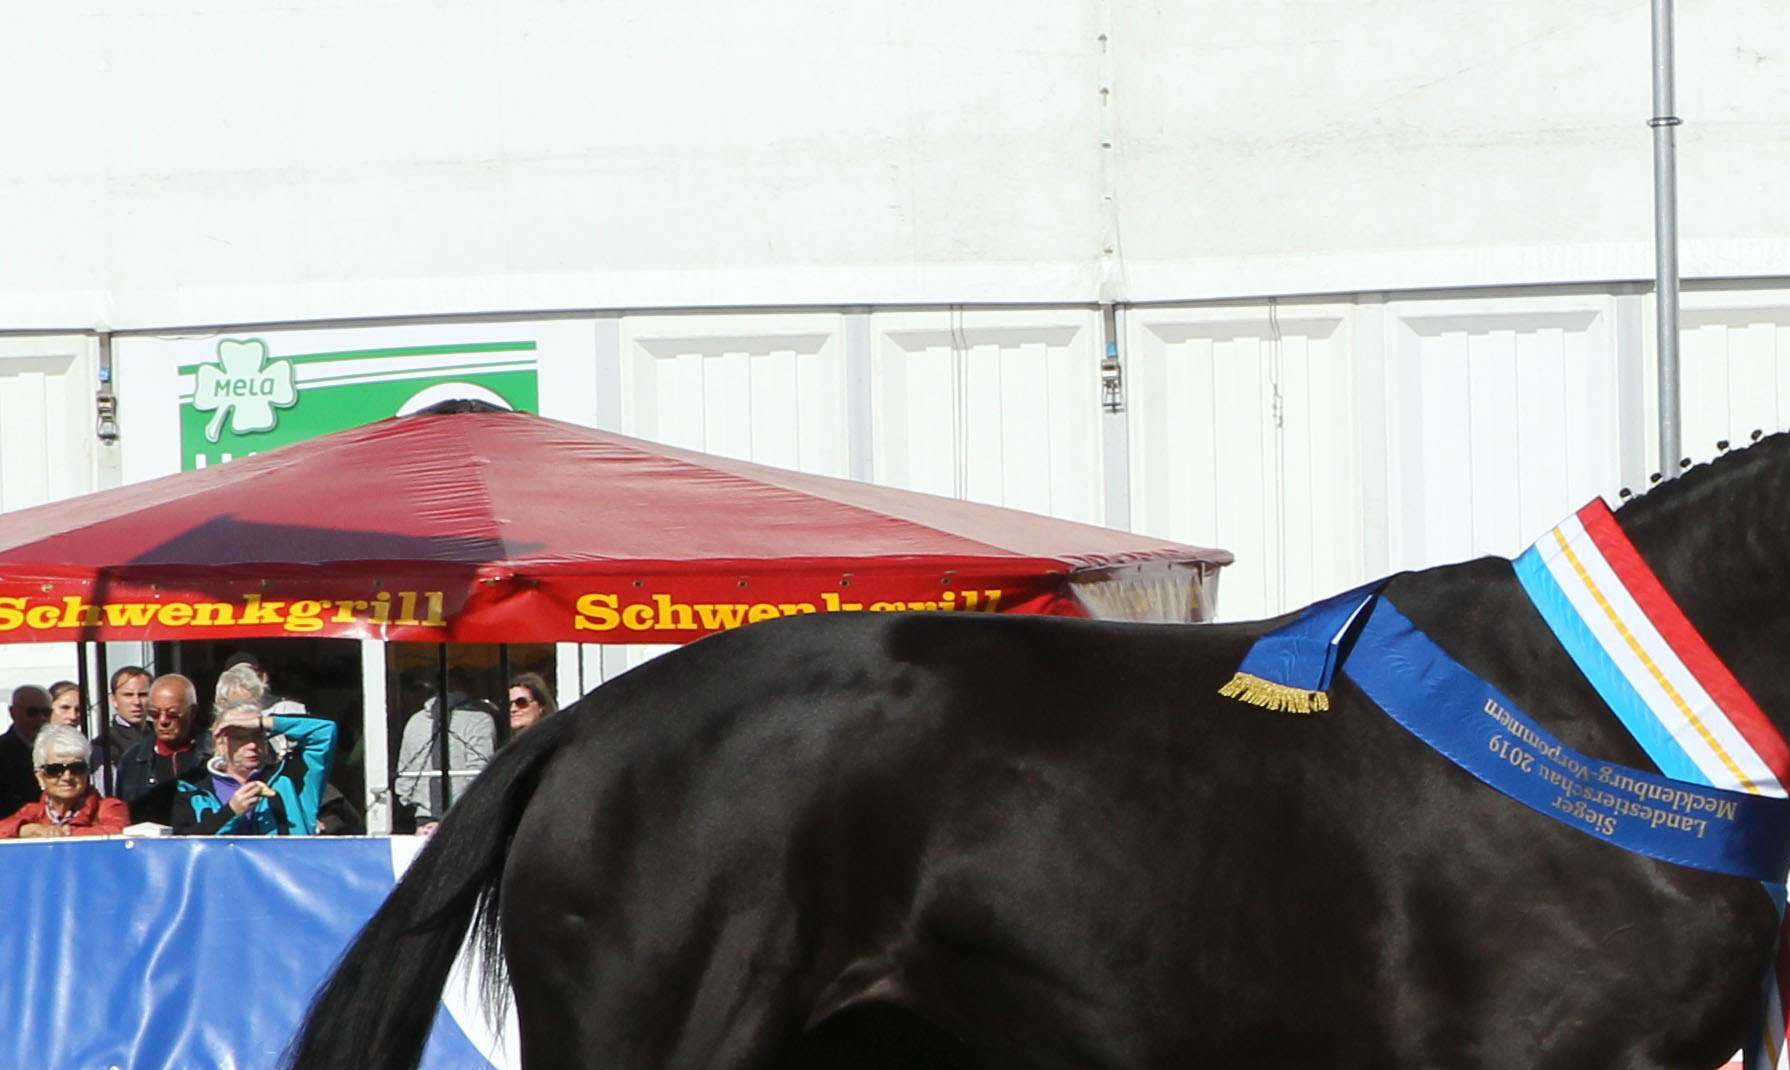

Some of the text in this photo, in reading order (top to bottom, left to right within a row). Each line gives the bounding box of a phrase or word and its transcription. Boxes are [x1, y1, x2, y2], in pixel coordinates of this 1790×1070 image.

[574, 589, 1002, 631] Schwekill
[1483, 698, 1739, 820] Mecklenburg-Vorpommern
[1489, 734, 1708, 838] Landestierschau 2019
[1551, 796, 1617, 836] Sieger
